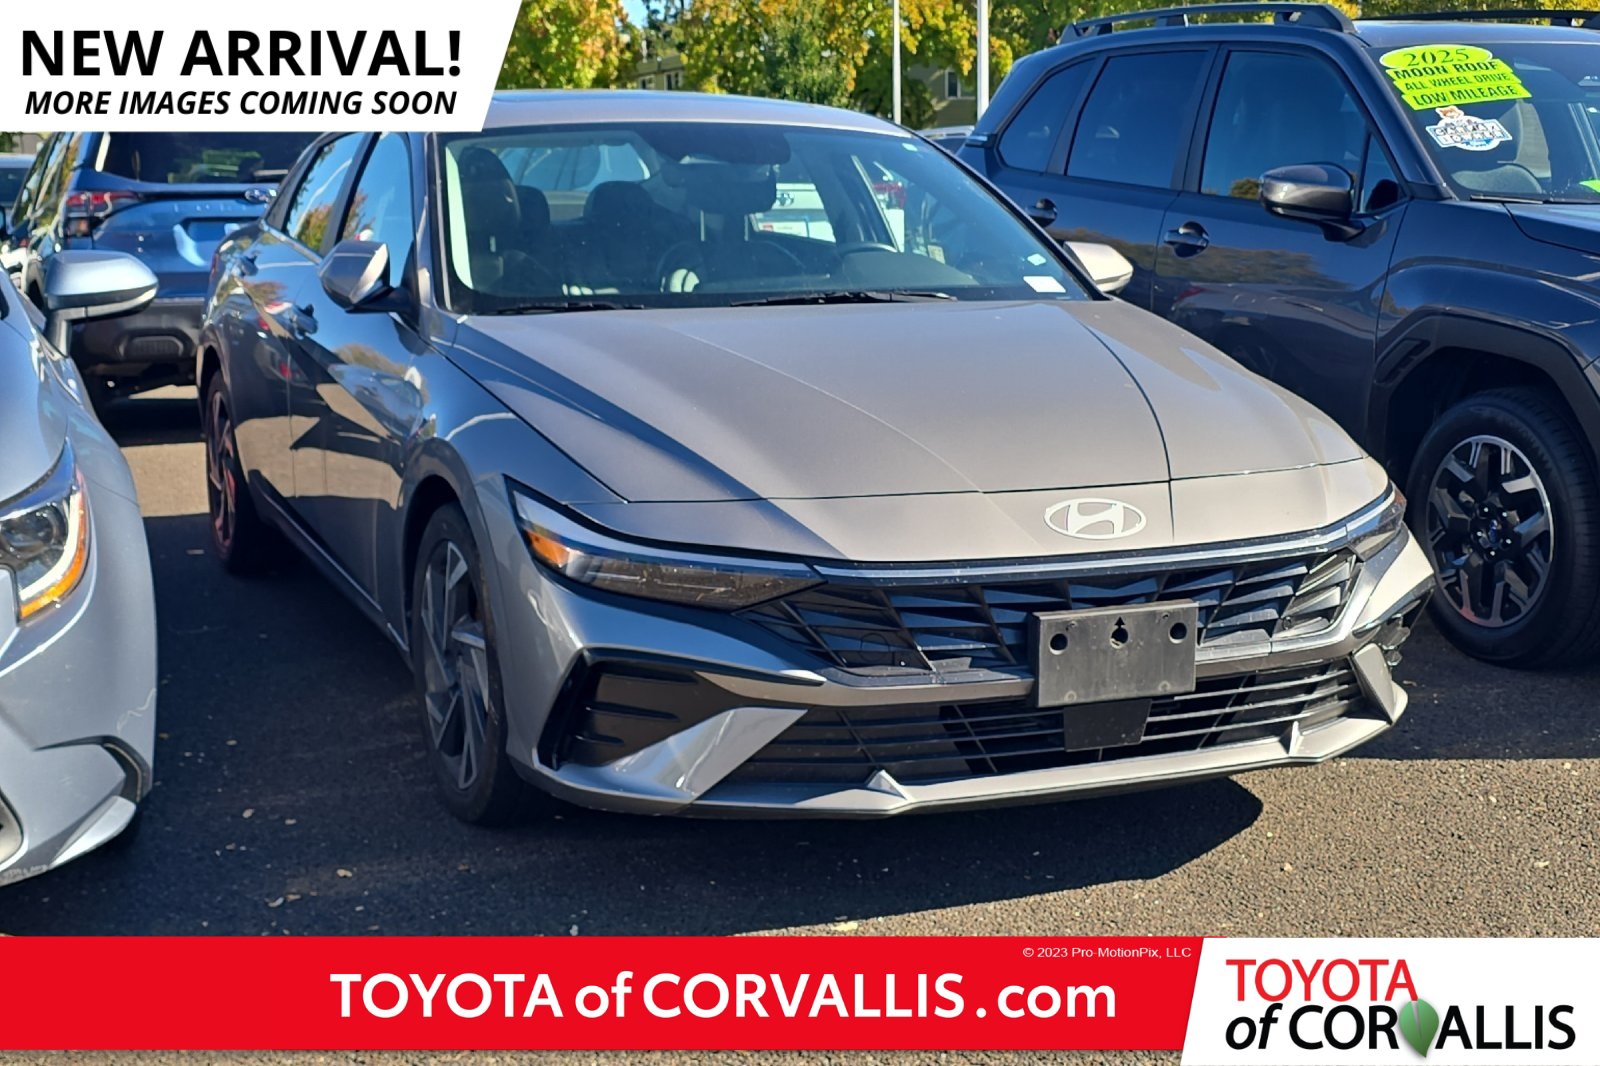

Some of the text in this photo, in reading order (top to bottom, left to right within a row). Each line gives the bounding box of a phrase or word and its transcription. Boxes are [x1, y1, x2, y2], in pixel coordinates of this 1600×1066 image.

[1404, 48, 1469, 67] 2025
[1394, 60, 1498, 79] MOON ROOF
[1405, 72, 1510, 91] ALL WHEEL DRIVE
[1413, 85, 1518, 106] LOW MILEAGE
